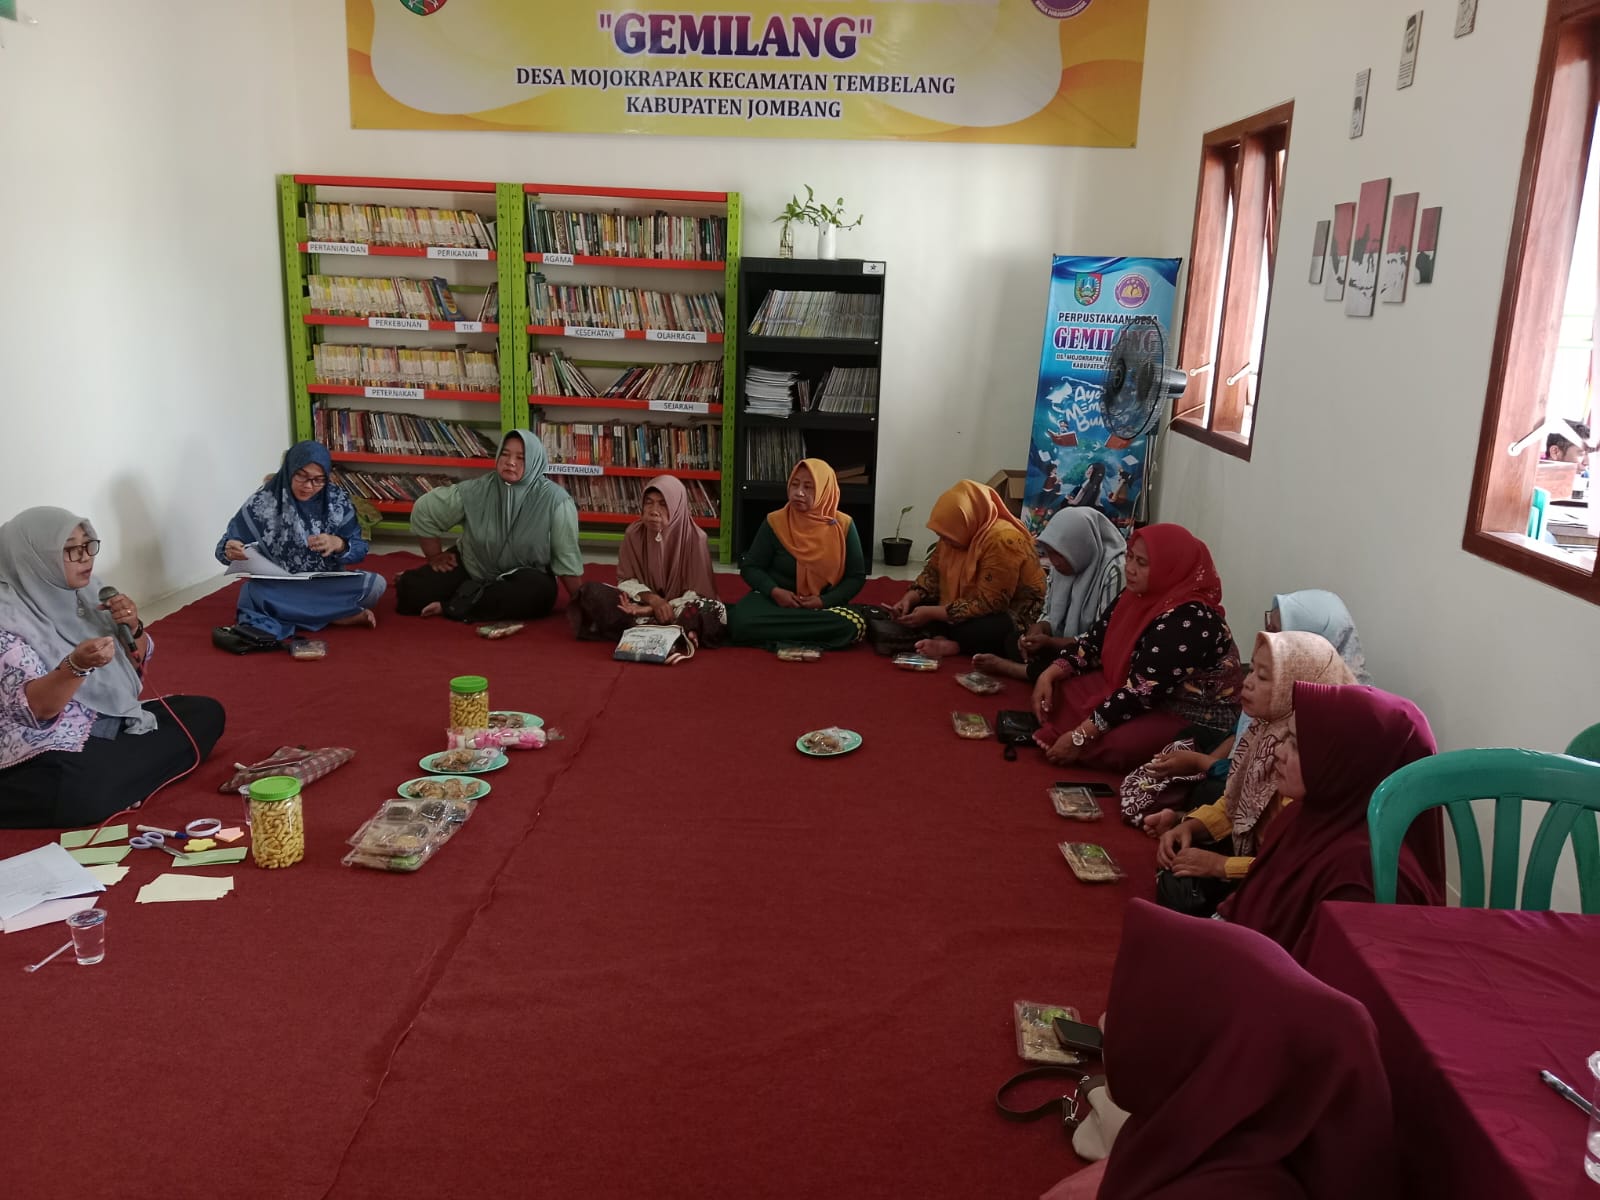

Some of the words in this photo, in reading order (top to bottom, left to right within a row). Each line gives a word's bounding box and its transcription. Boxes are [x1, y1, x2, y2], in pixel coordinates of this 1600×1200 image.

[600, 13, 872, 58] "GEMILANG"
[516, 68, 566, 85] DESA
[571, 69, 704, 89] MOJOKRAPAK
[709, 71, 828, 91] KECAMATAN
[833, 74, 955, 94] TEMBELANG
[626, 96, 742, 115] KABUPATEN
[747, 99, 841, 119] JOMBANG
[310, 244, 348, 252] PERTANIAN
[350, 245, 366, 253] DAN
[544, 255, 572, 264] AGAMA
[1058, 312, 1132, 324] PERPUSTAKAAN
[375, 320, 422, 328] PERKEBUNAN
[575, 329, 614, 337] KESEHATAN
[657, 332, 696, 340] OLAHRAGA
[372, 389, 417, 397] PETERNAKAN
[663, 402, 694, 410] SEJARAH
[548, 465, 600, 474] PENGETAHUAN
